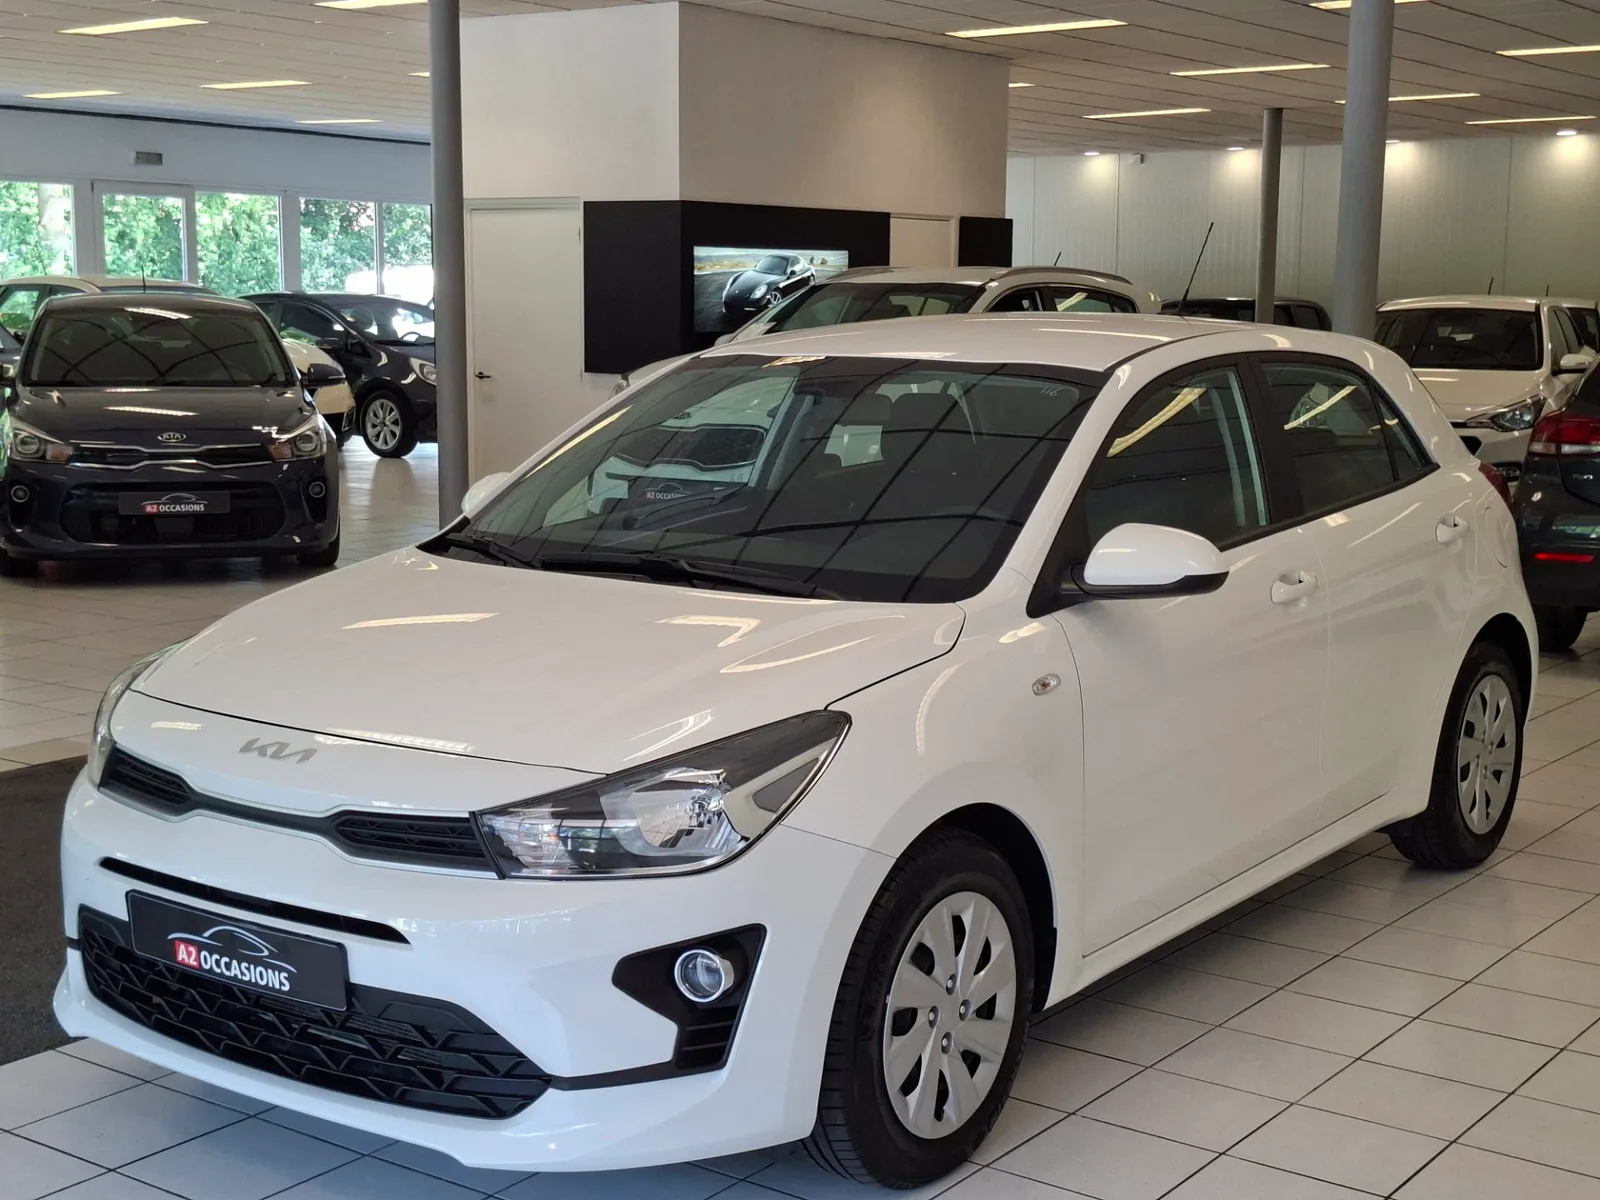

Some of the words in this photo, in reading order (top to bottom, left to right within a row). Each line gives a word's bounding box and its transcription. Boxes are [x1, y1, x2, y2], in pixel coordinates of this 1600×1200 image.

[145, 504, 159, 513] A2
[159, 503, 205, 512] OCCASIONS
[239, 737, 318, 764] KIA
[177, 943, 198, 966] A2
[200, 952, 291, 992] OCCASIONS
